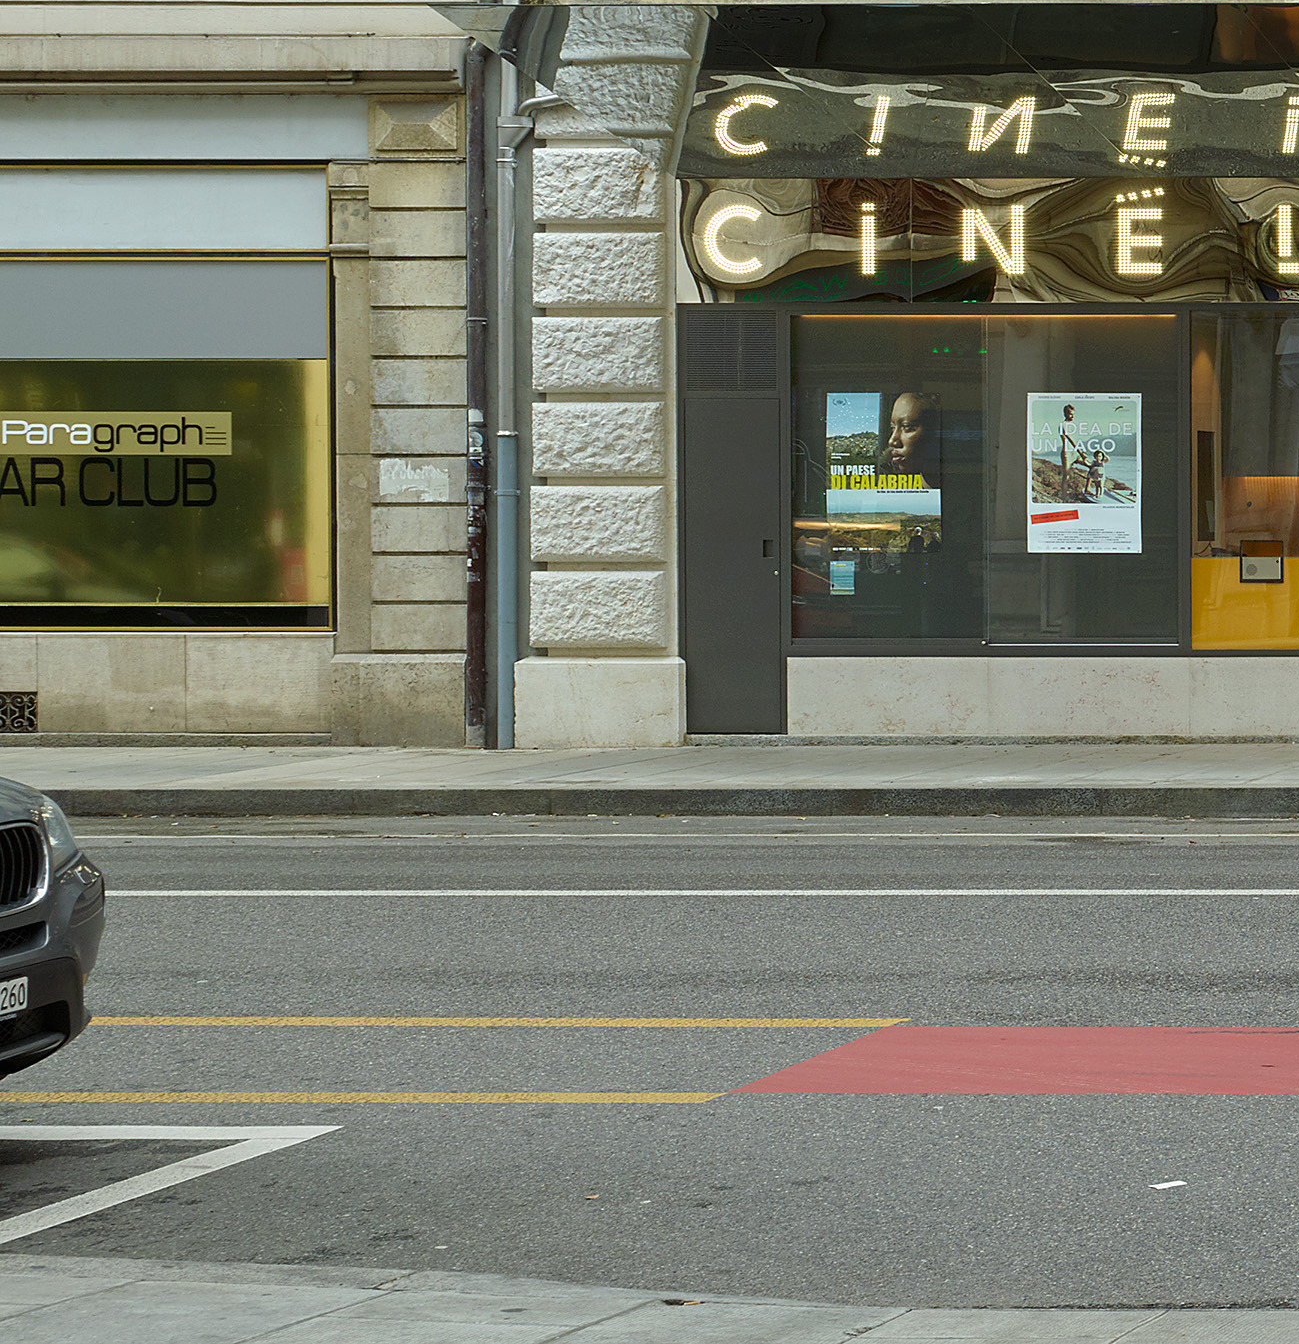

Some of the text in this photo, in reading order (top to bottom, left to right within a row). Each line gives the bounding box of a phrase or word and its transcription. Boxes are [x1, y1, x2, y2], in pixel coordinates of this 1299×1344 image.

[2, 417, 203, 452] Paragraph
[1032, 423, 1132, 435] LA IDEA DE
[1032, 439, 1116, 452] UN LAGO
[831, 465, 875, 475] UN PAESE
[79, 457, 217, 506] CLUB
[831, 475, 922, 489] DI CALABRIA
